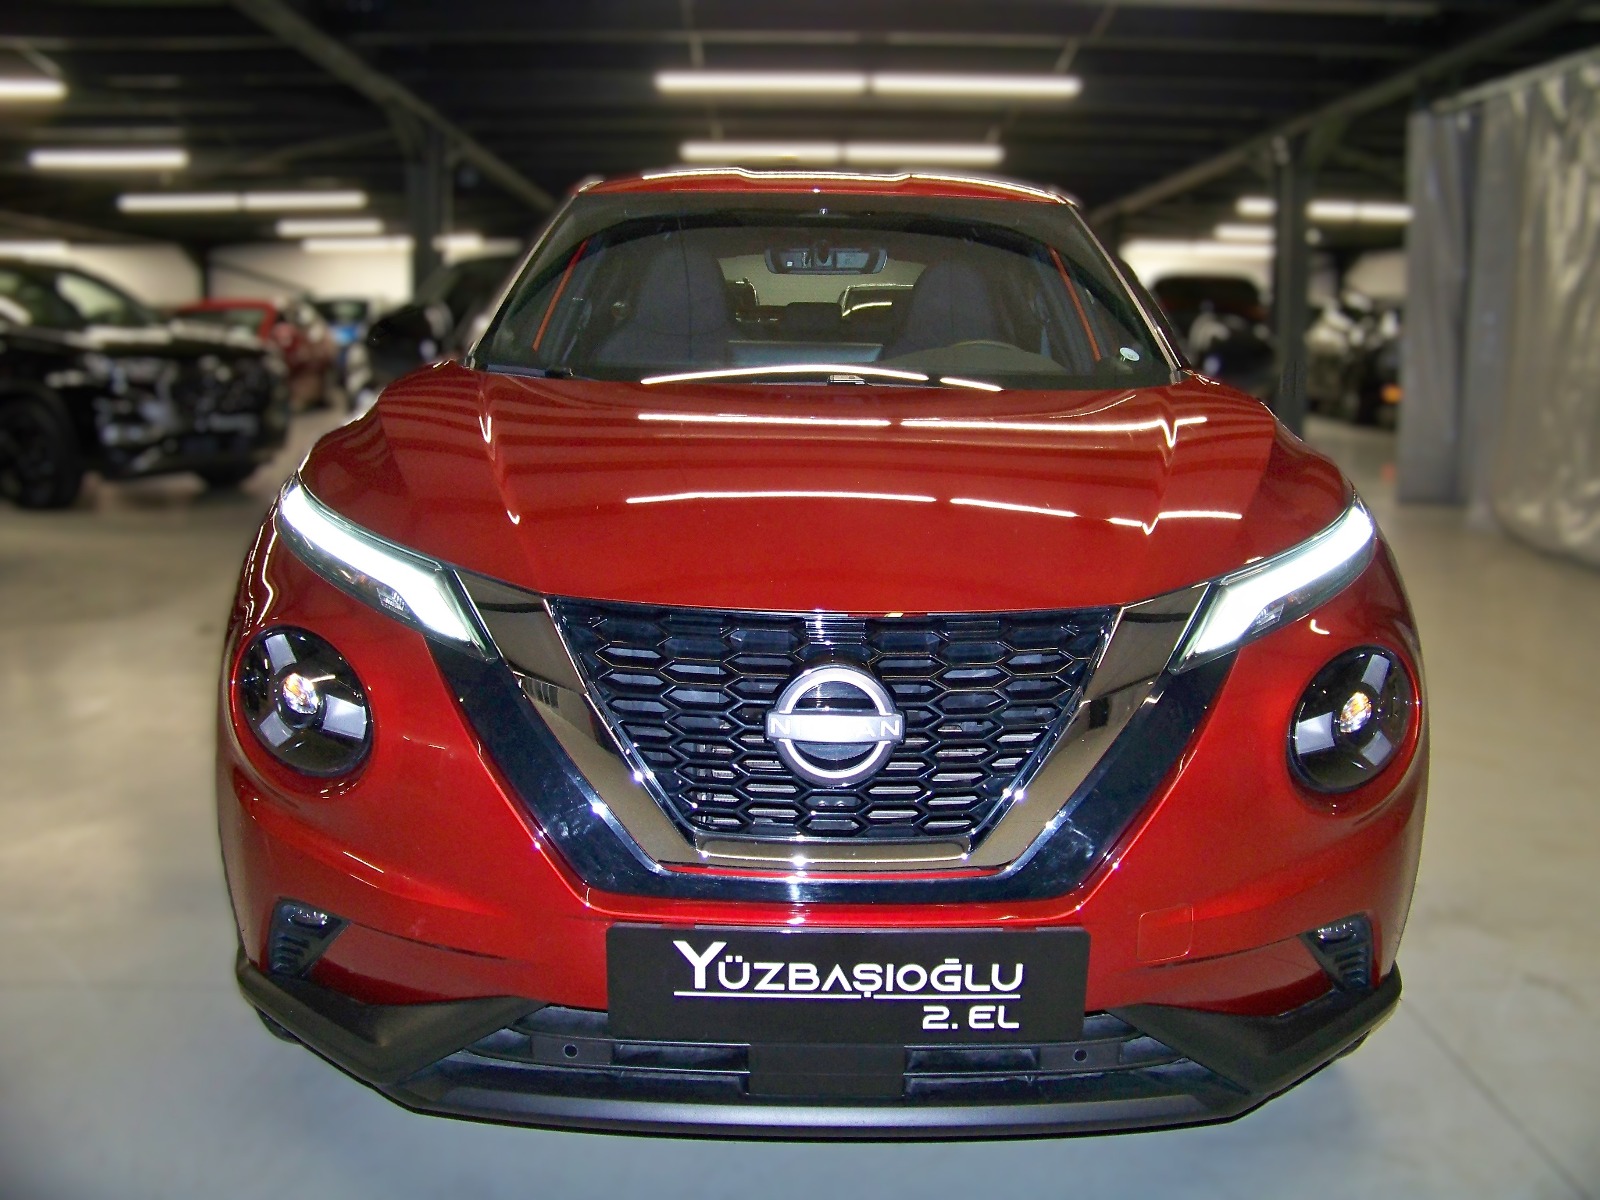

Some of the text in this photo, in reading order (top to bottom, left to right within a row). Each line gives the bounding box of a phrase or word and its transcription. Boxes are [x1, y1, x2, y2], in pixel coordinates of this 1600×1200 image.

[769, 717, 900, 737] NAN
[923, 1006, 1020, 1029] 2. EL
